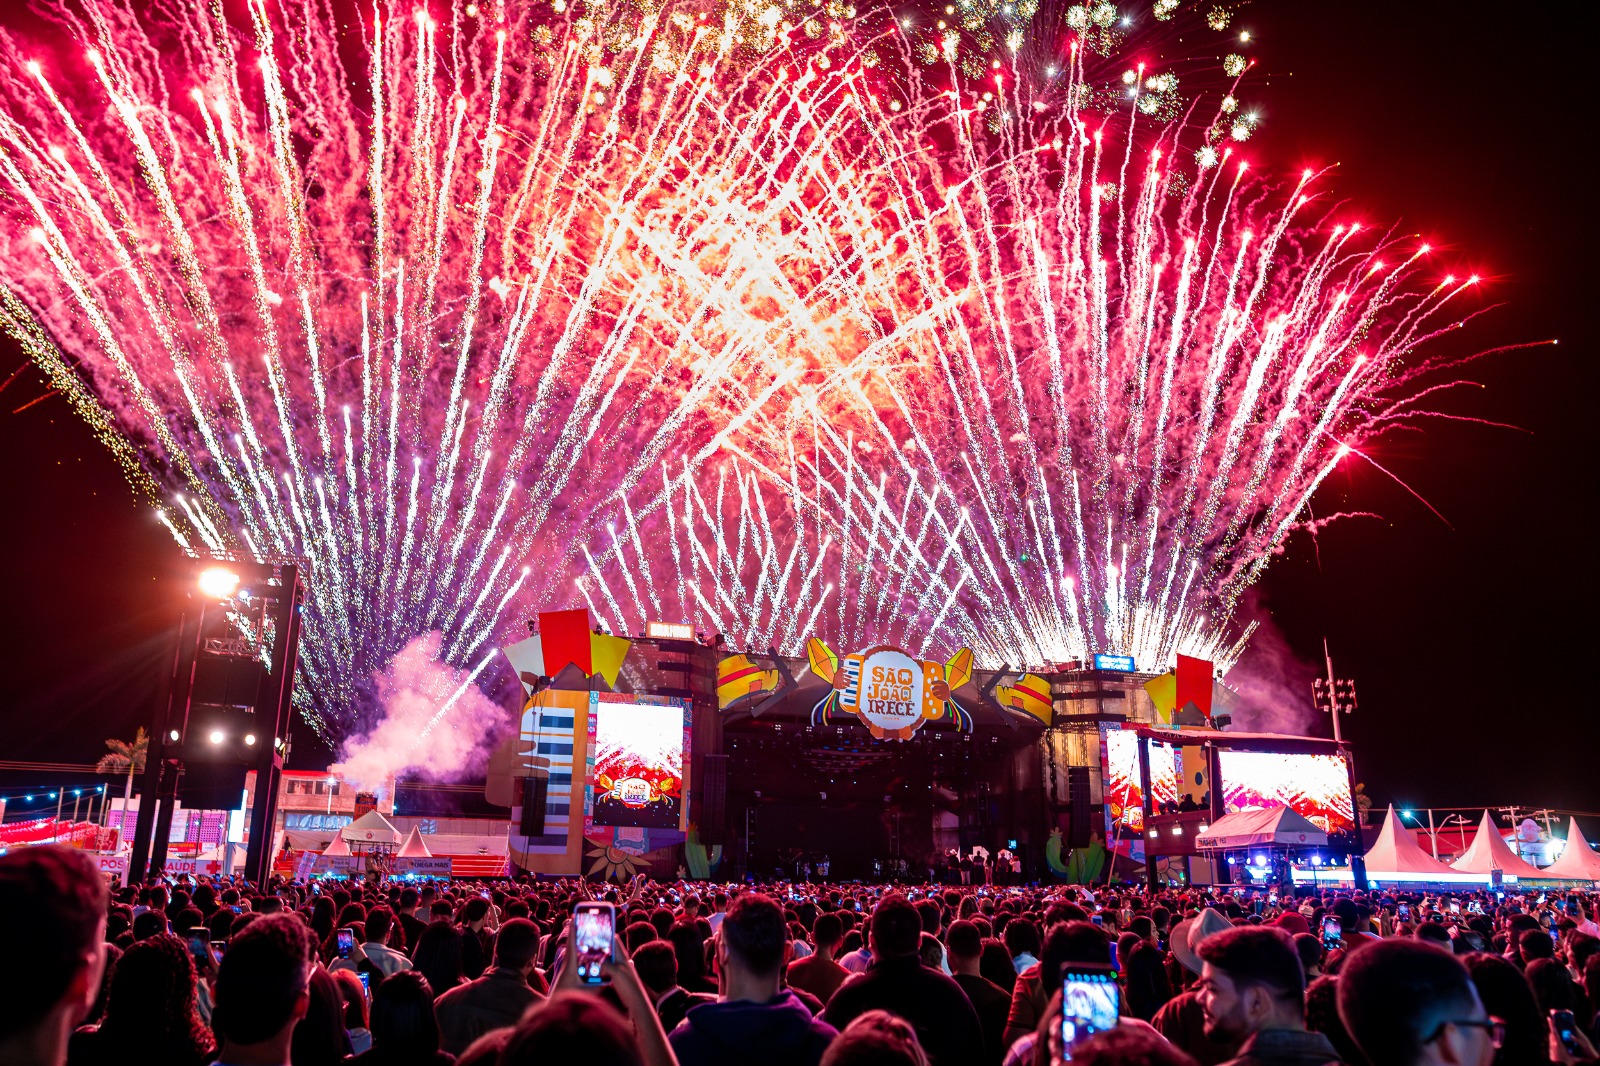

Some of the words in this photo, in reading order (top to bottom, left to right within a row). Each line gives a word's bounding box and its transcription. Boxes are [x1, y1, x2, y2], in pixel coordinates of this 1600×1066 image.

[872, 666, 912, 687] SÃO
[867, 684, 911, 702] JOÃO
[867, 700, 915, 716] IRECÊ
[100, 859, 124, 869] POS
[164, 859, 195, 872] AÚDE
